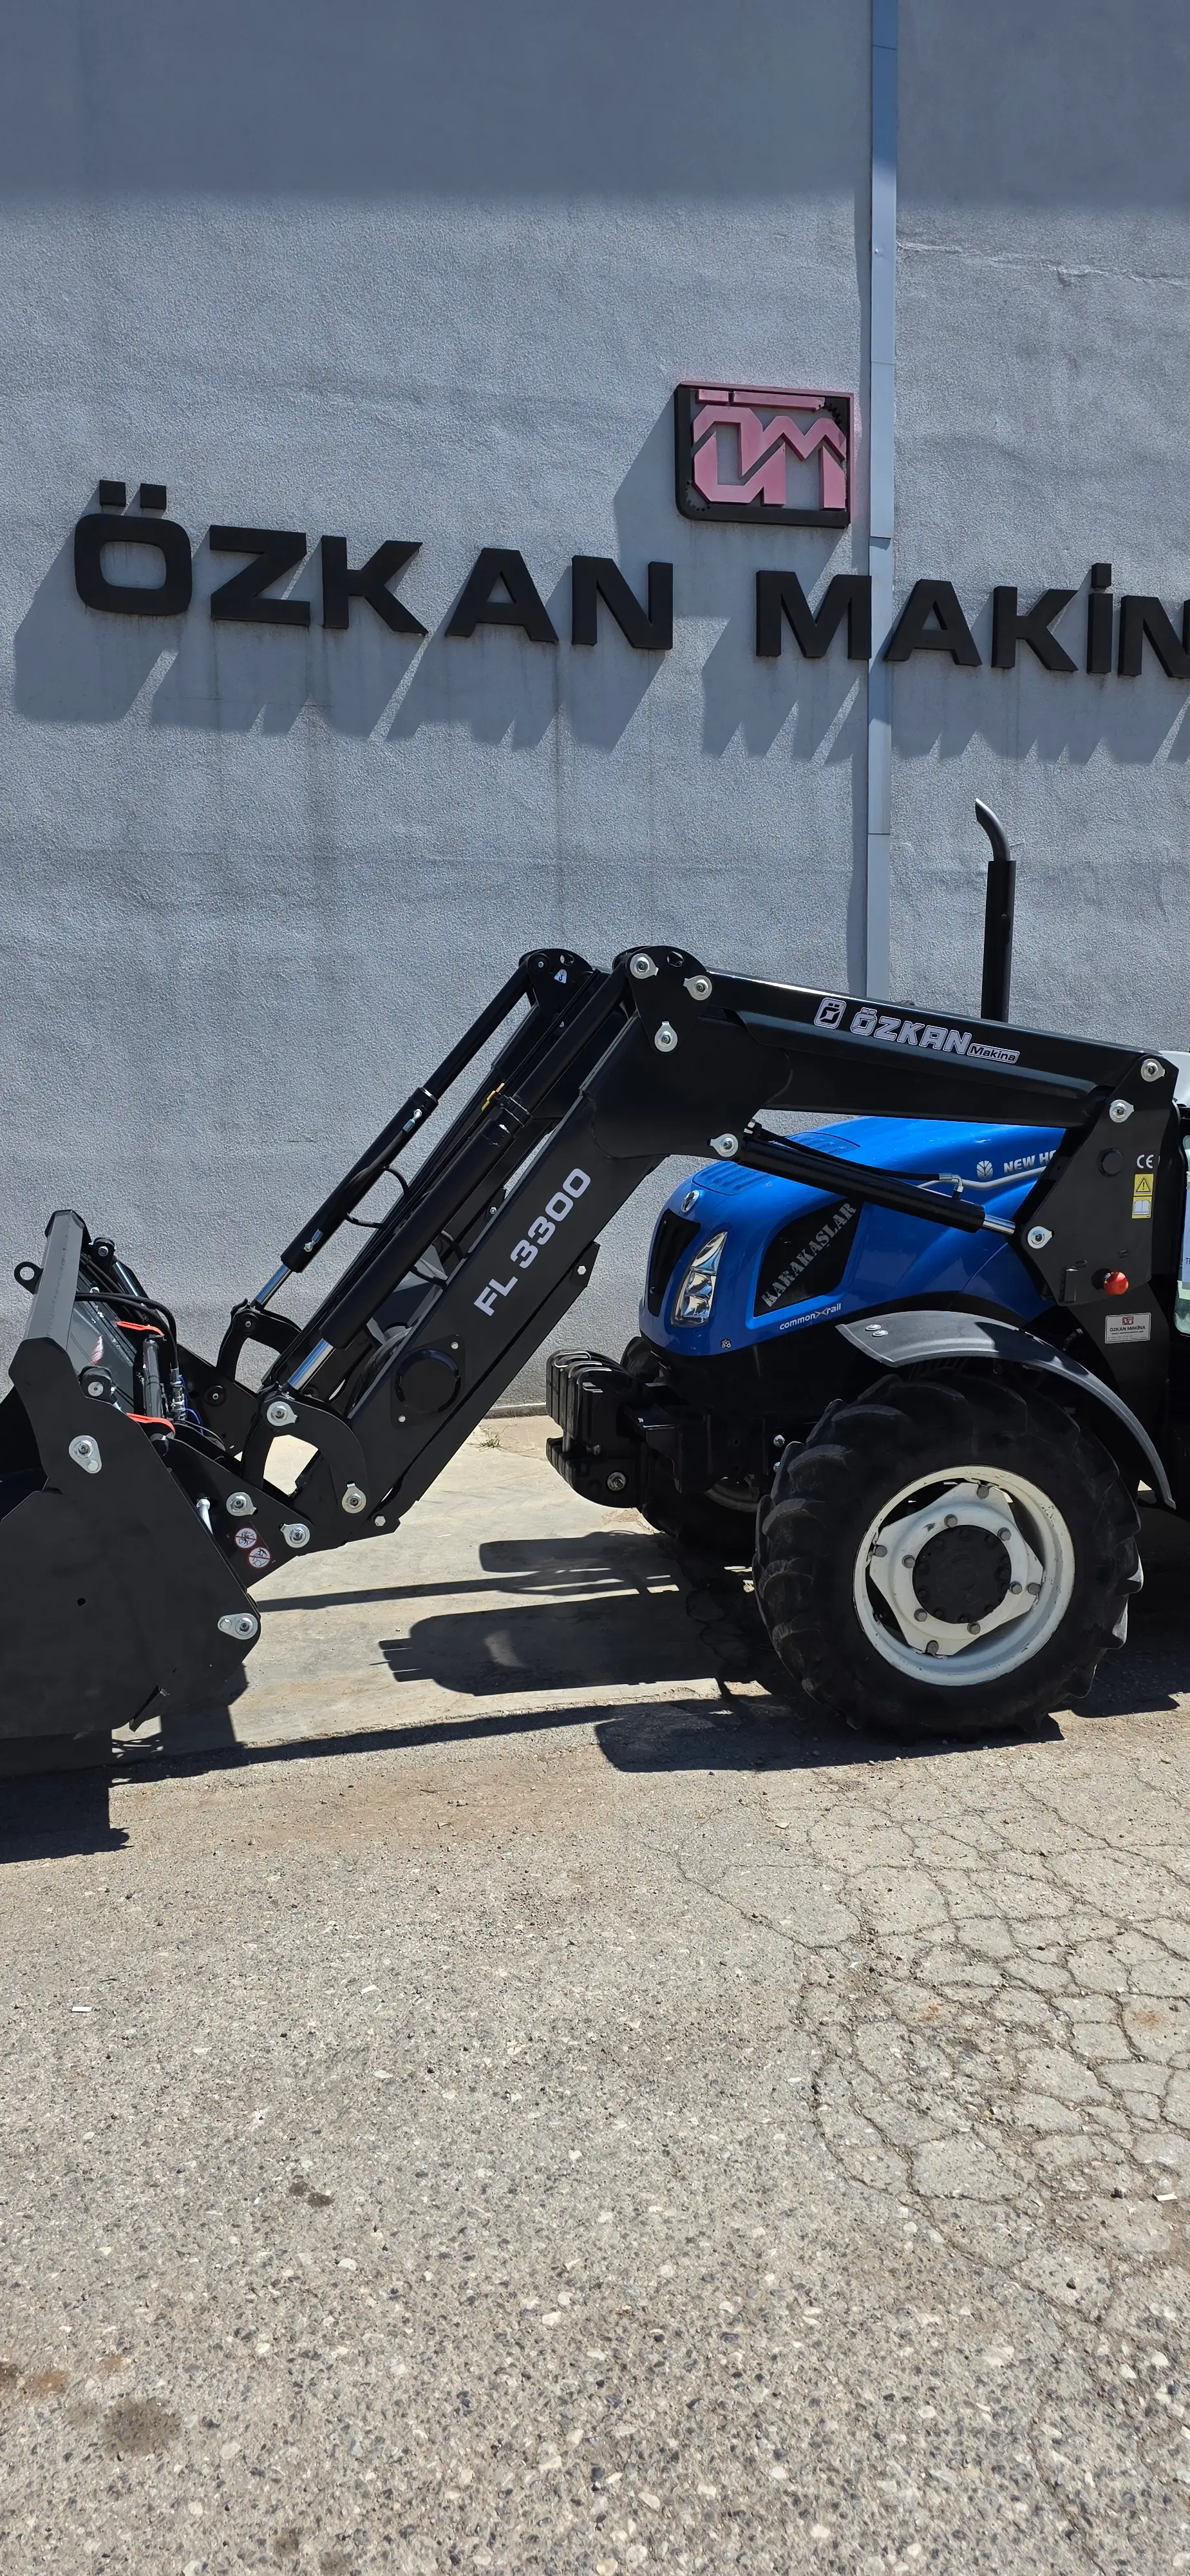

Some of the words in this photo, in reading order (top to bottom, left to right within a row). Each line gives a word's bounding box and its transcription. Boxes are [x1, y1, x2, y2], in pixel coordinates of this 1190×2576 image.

[74, 480, 673, 650] ÖZKAN
[850, 1007, 972, 1054] ÖZKAN
[970, 1046, 1016, 1062] Makina
[1004, 1155, 1035, 1172] NEW
[1137, 1154, 1154, 1169] CE
[474, 1276, 518, 1316] FL
[510, 1168, 591, 1269] 3300
[761, 1203, 856, 1307] KARAKAŞLAR
